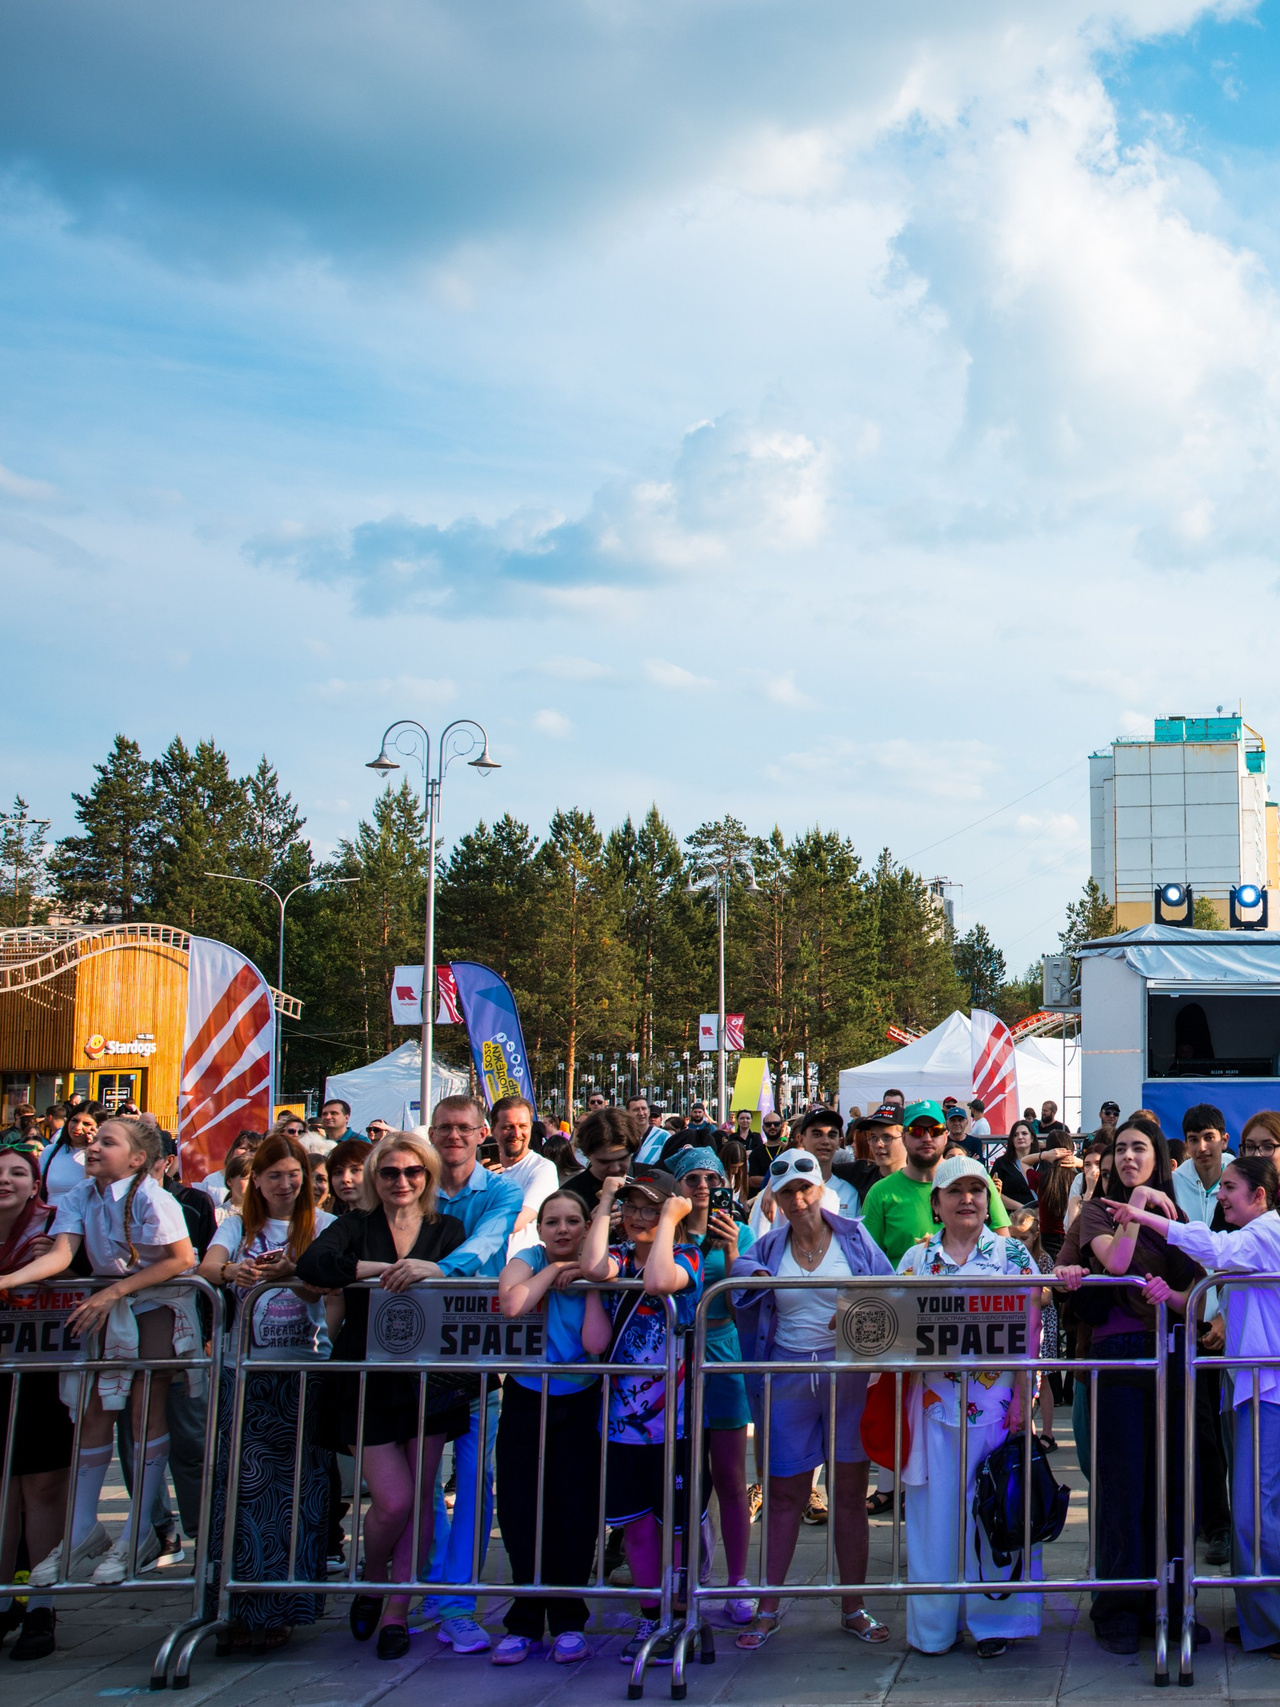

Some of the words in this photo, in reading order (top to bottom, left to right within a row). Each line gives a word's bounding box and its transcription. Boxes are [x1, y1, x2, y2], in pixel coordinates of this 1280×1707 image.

[108, 1041, 156, 1056] Stardogs
[27, 1292, 85, 1310] EVENT
[443, 1296, 488, 1312] YOUR
[917, 1296, 965, 1312] YOUR
[968, 1295, 1027, 1312] EVENT
[934, 1314, 980, 1322] ПРОСТРАНСТВО
[440, 1324, 543, 1355] SPACE
[916, 1323, 1026, 1356] SPACE
